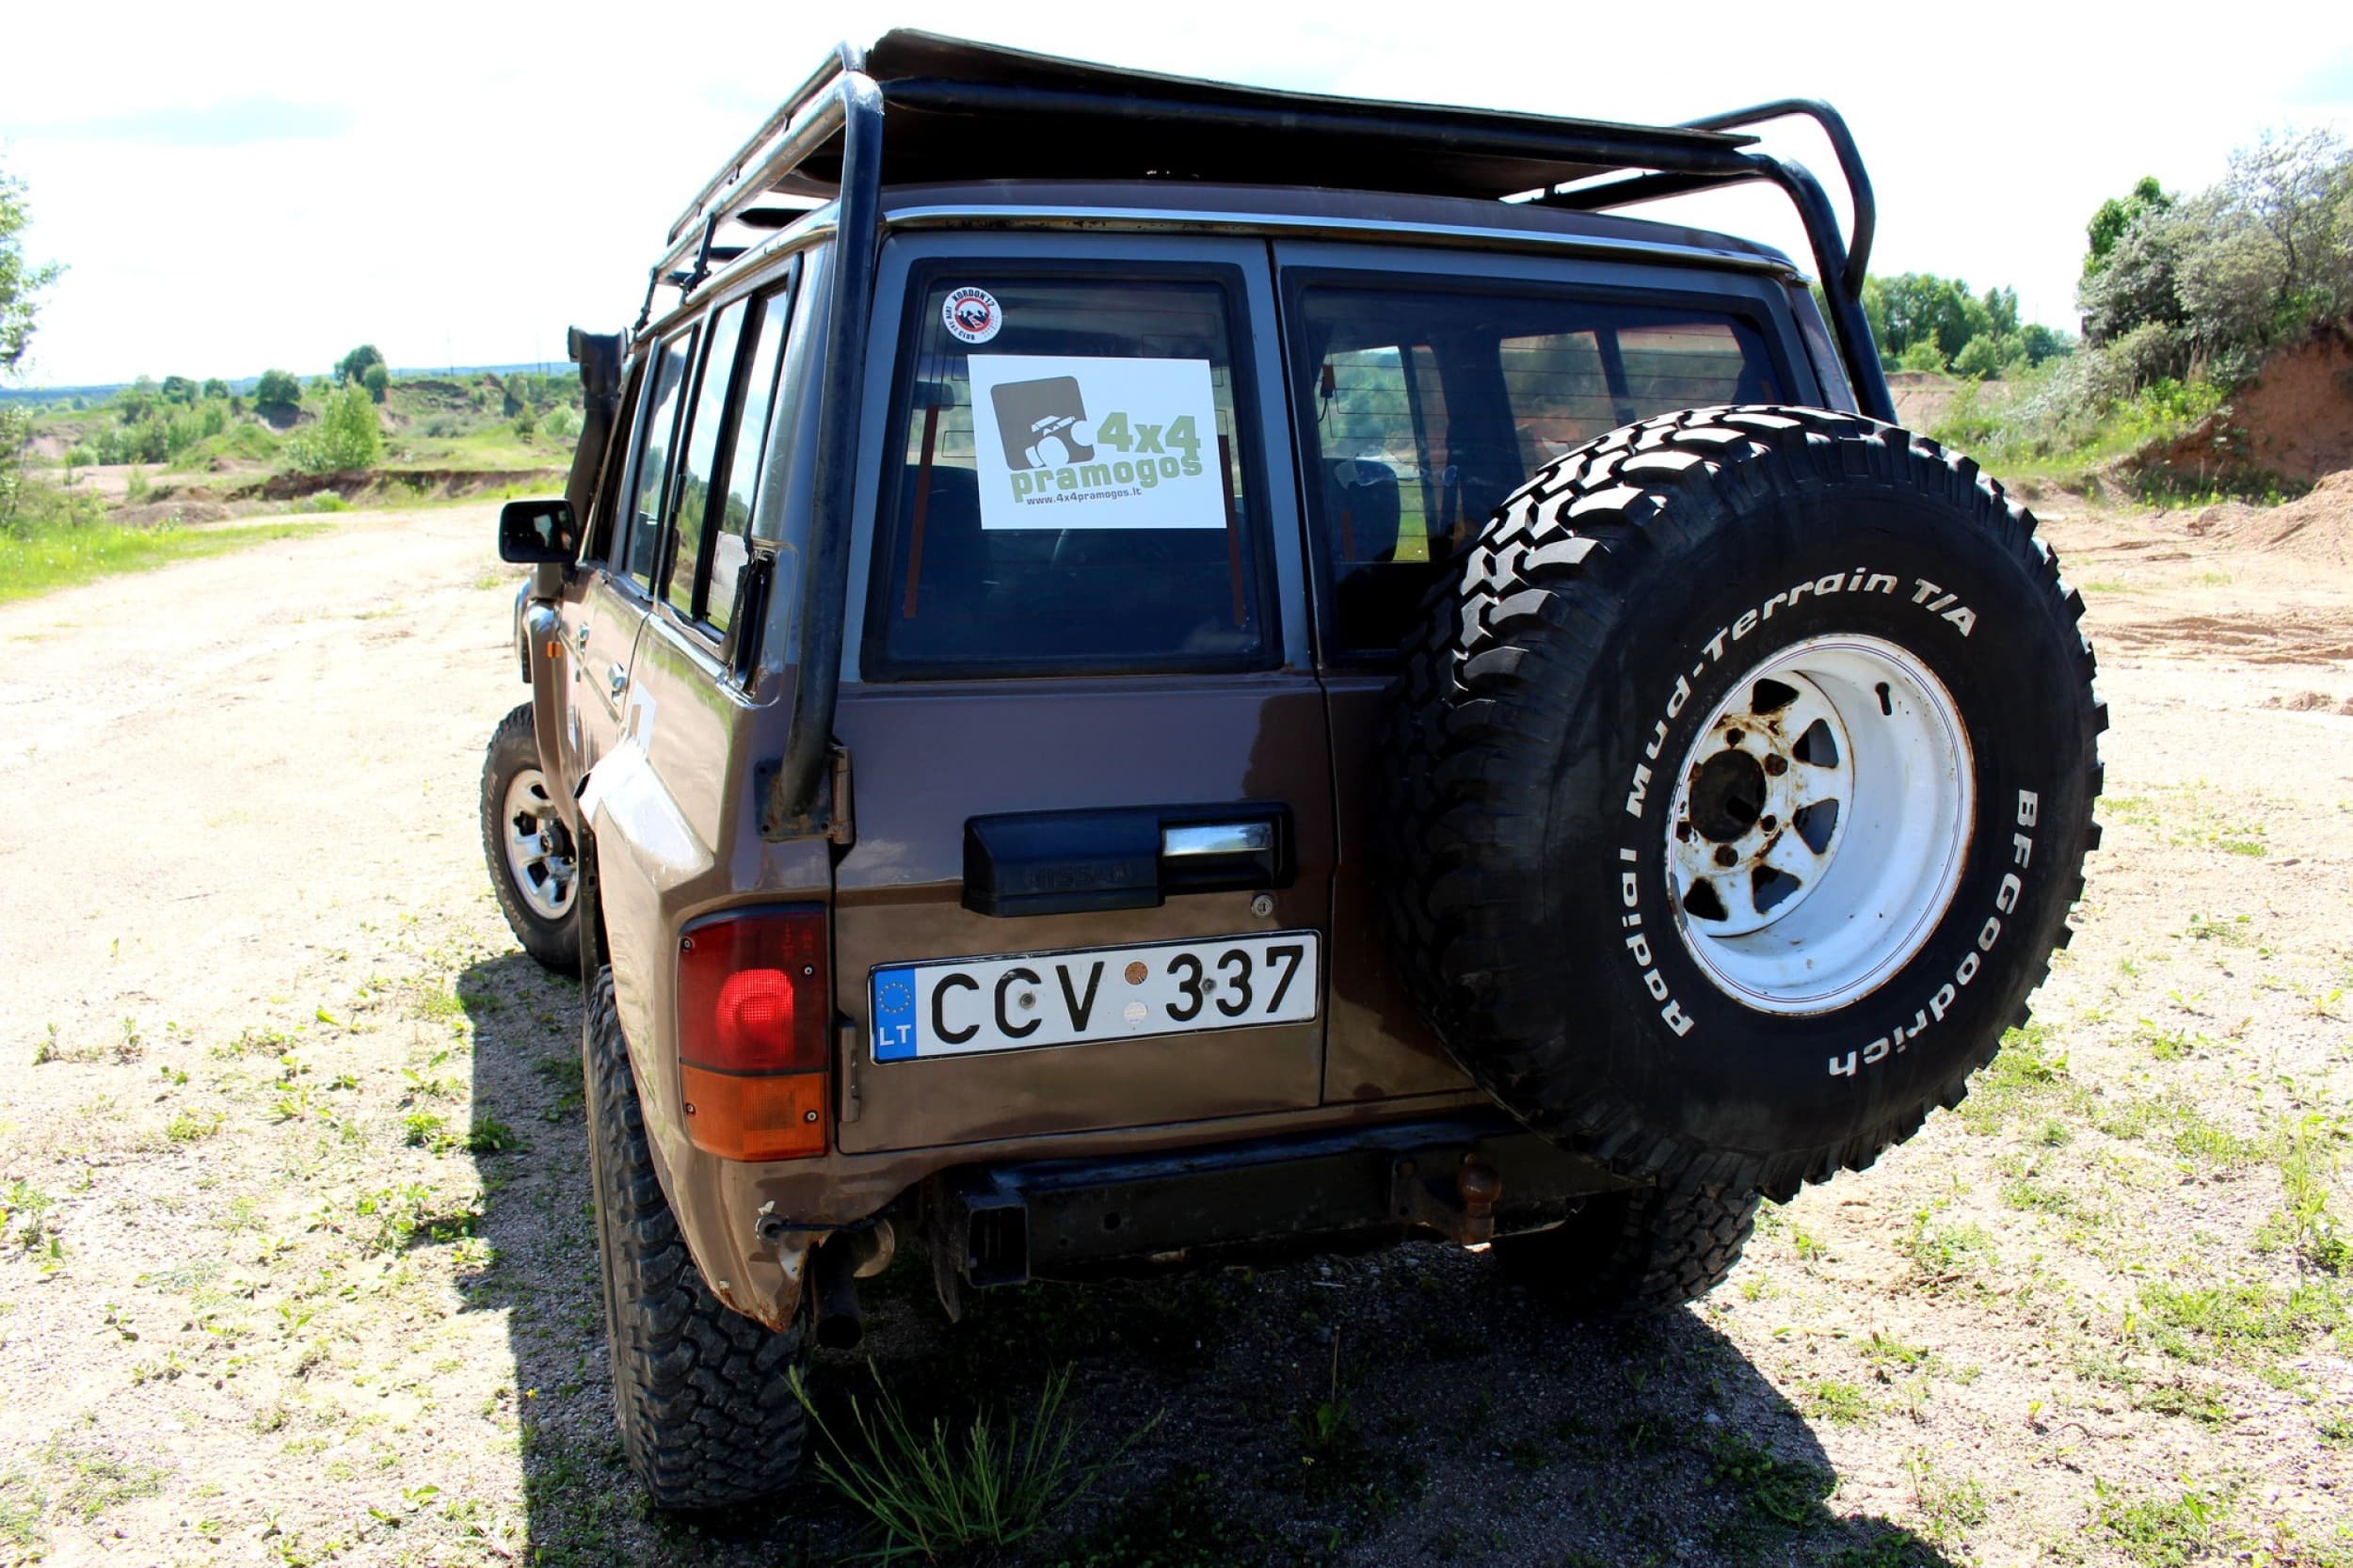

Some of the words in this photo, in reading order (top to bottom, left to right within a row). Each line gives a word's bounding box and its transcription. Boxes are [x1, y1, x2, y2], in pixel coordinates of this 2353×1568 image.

[1096, 411, 1201, 455] 4x4
[1010, 455, 1204, 504] pramogos
[1026, 486, 1143, 505] www.4x4pramogos.lt
[1912, 577, 1977, 637] T/A
[1625, 567, 1897, 819] Mud-Terrain
[1619, 847, 1695, 1037] Radial
[1829, 789, 2039, 1078] BFGoodrich
[931, 960, 1106, 1045] CCV
[1165, 944, 1305, 1022] 337
[879, 1024, 912, 1047] LT
